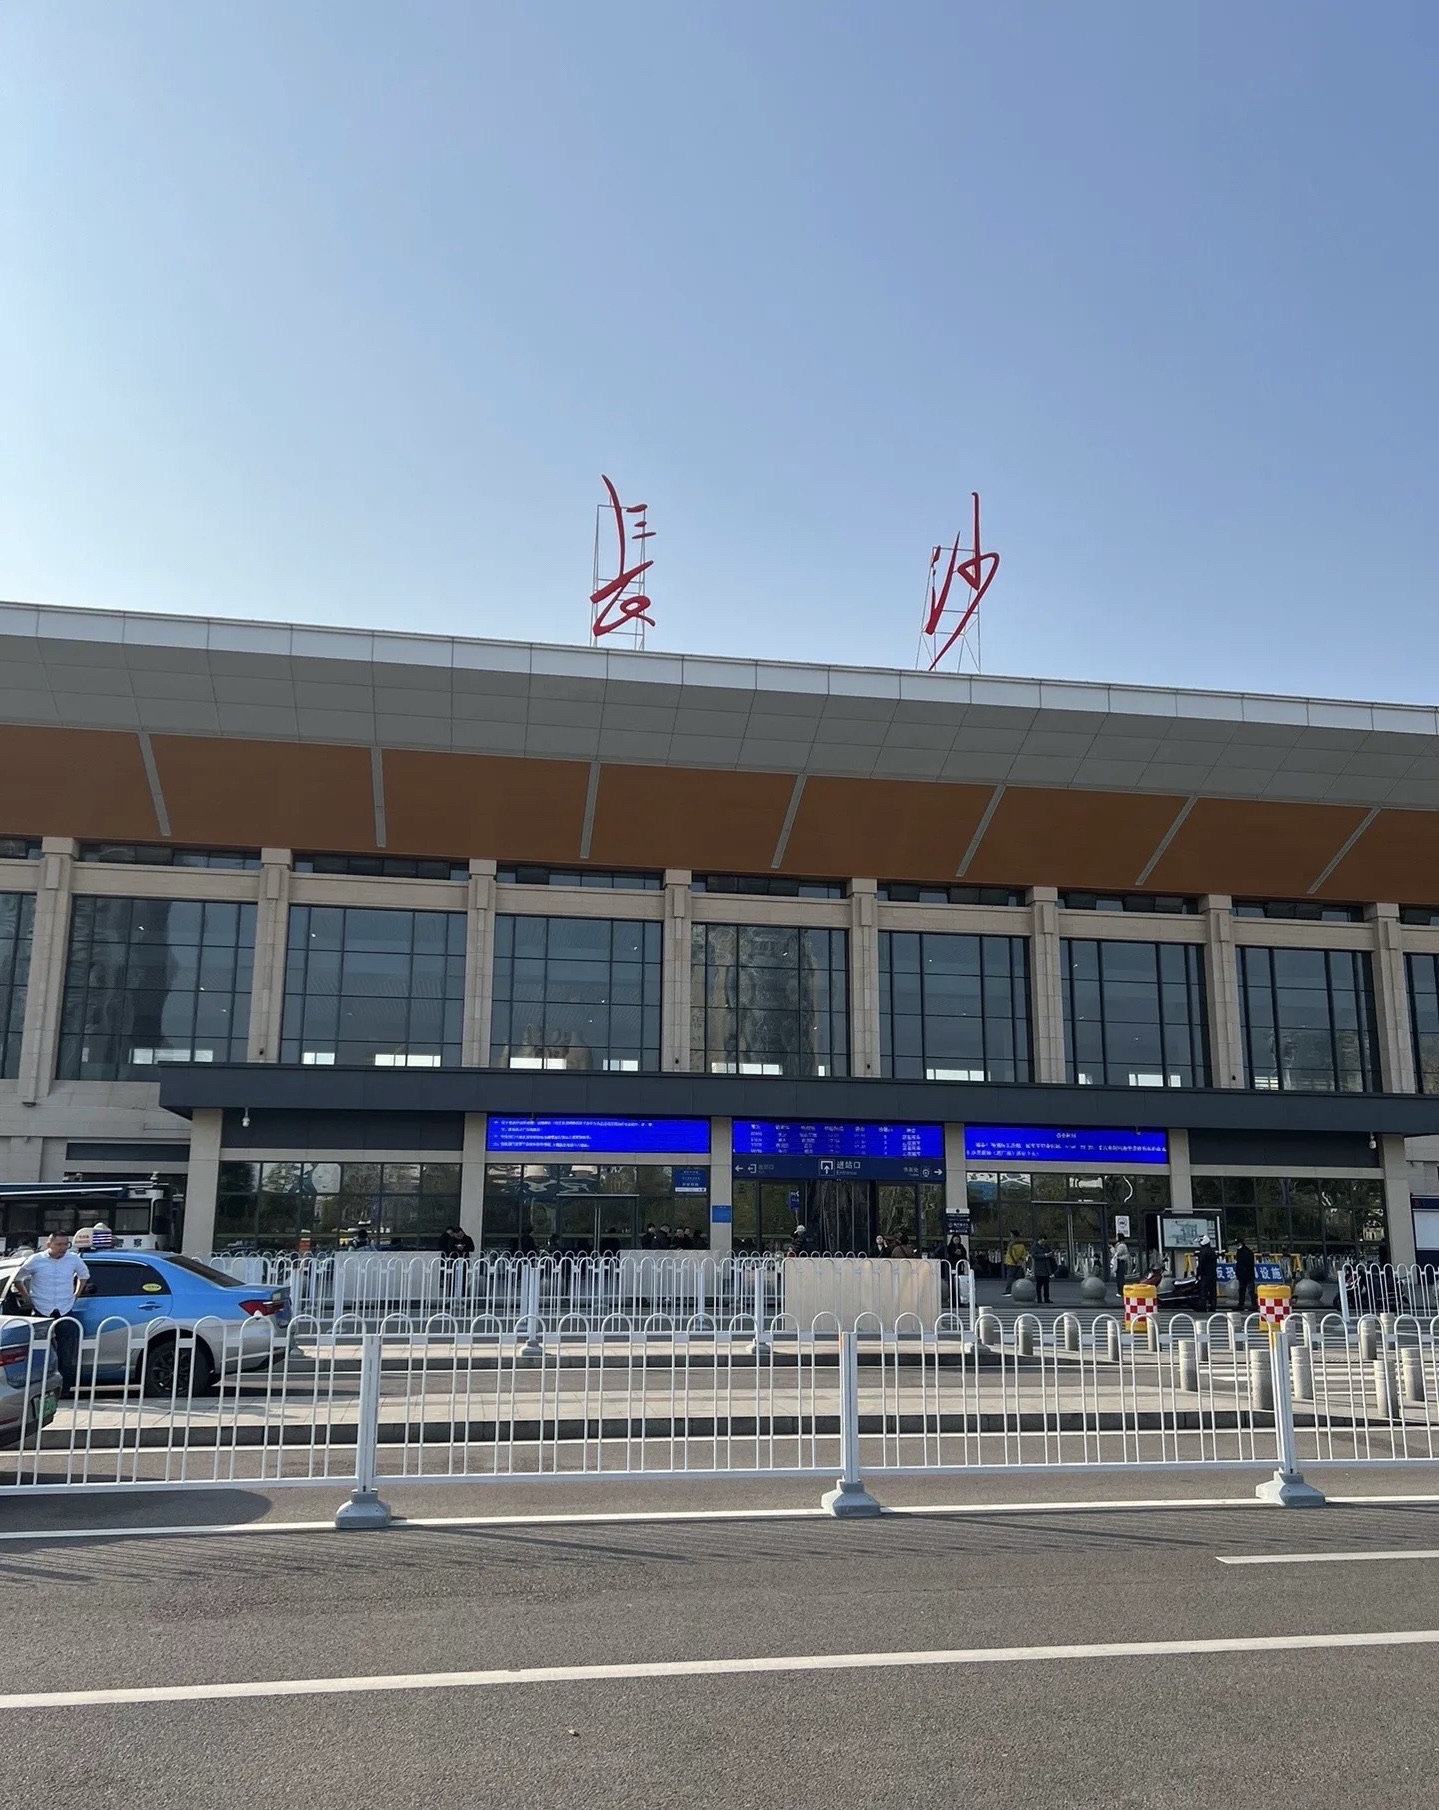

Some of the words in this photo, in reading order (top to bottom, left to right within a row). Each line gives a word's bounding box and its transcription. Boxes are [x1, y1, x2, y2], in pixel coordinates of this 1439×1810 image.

[836, 1160, 861, 1170] 进站口
[1215, 1266, 1282, 1280] 反恐设施
